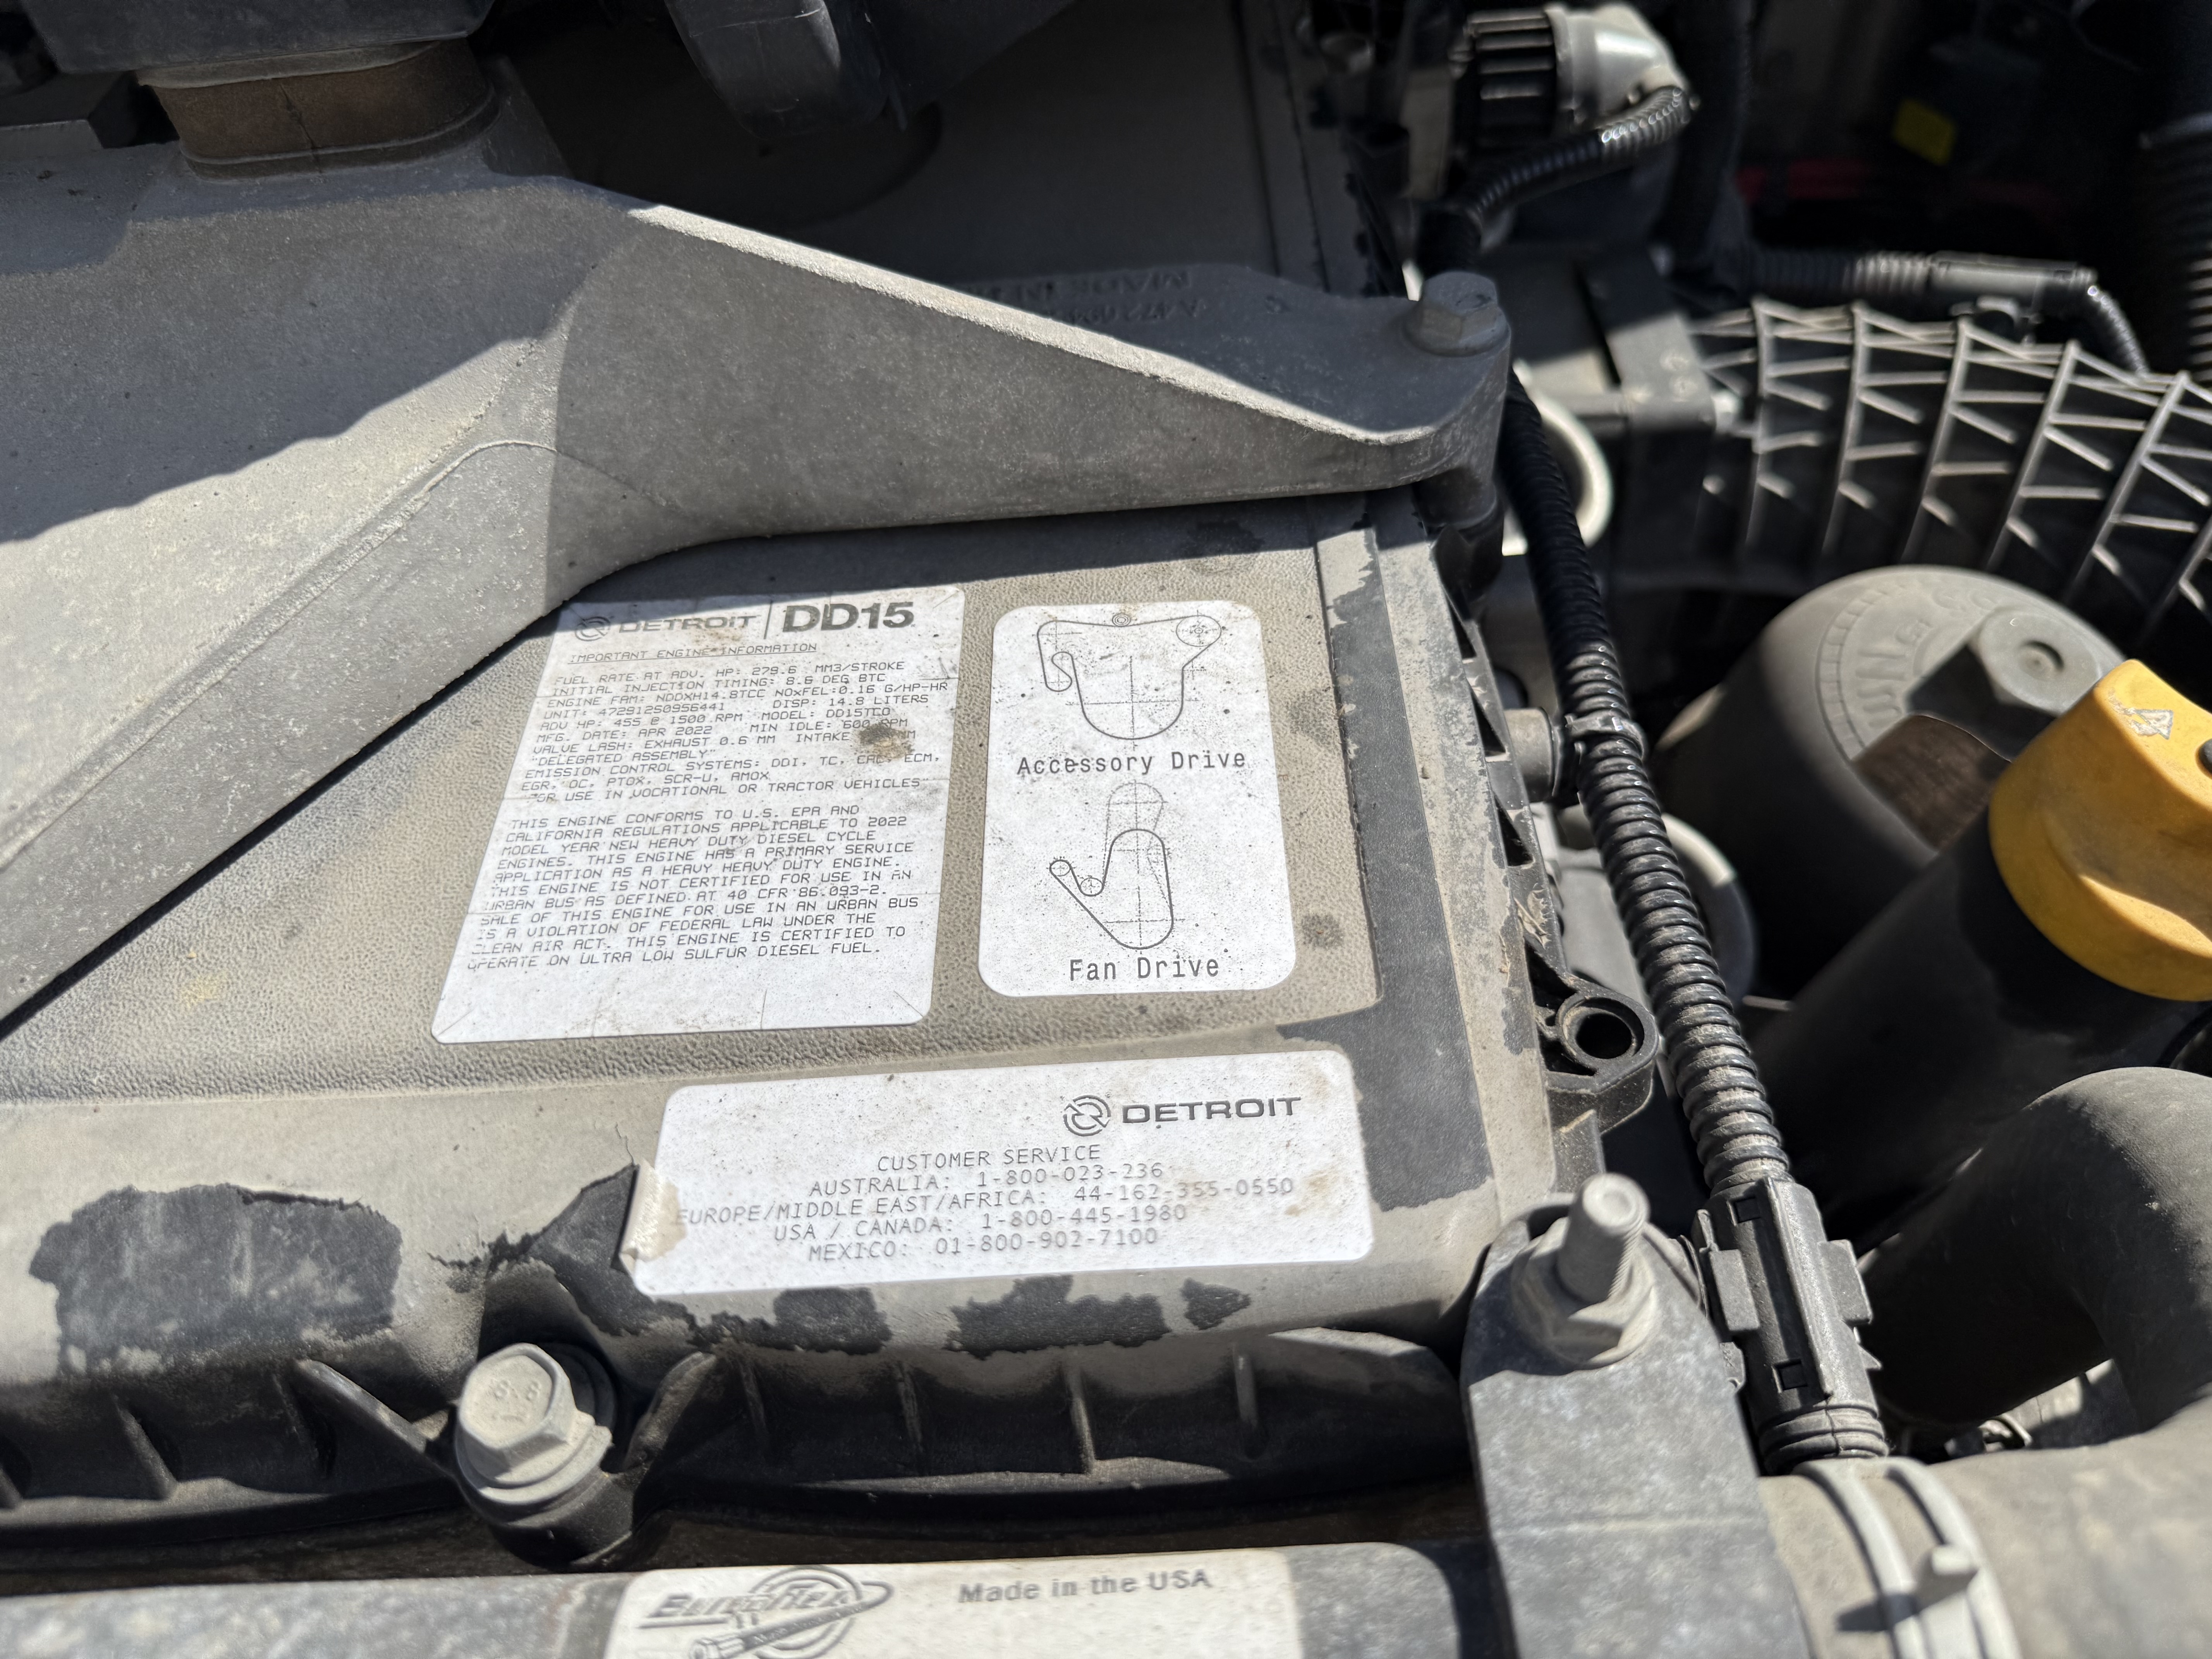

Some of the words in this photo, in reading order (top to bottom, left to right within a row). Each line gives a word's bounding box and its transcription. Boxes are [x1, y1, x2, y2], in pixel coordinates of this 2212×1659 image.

[619, 615, 758, 634] DETROIT
[782, 602, 914, 632] DD15
[570, 651, 648, 663] IMPORTANT
[656, 648, 711, 658] ENGINE
[718, 643, 817, 655] INFORMATION
[550, 685, 612, 697] INITIAL
[624, 680, 704, 692] INJECTION
[714, 677, 774, 687] TIMING:
[786, 675, 813, 685] 8.6
[822, 674, 849, 684] DEG
[859, 673, 885, 682] BTC
[554, 676, 588, 685] FUEL
[599, 673, 635, 682] RATE
[670, 670, 704, 678] ADV.
[715, 668, 740, 677] HP:
[752, 665, 797, 675] 279.6
[815, 661, 905, 673] MM3/STROKE
[543, 709, 587, 719] UNIT:
[772, 699, 816, 708] DISP:
[829, 696, 864, 706] 14.8
[874, 694, 928, 704] LITERS
[547, 697, 602, 708] ENGINE
[610, 696, 644, 704] FAM:
[656, 689, 765, 702] NDDXH14.8TCC
[884, 680, 948, 692] G/HP-HR
[536, 733, 570, 742] MFG.
[582, 730, 626, 740] DATE:
[638, 728, 666, 737] APR
[675, 725, 712, 735] 2022
[749, 723, 777, 732] MIN
[788, 721, 831, 731] IDLE:
[843, 720, 870, 729] 600
[880, 718, 907, 726] RPM
[540, 721, 568, 730] ADV
[576, 720, 602, 728] HP:
[613, 717, 642, 726] 455
[650, 717, 659, 725] @
[670, 714, 706, 725] 1500
[714, 713, 742, 722] RPM
[761, 711, 814, 720] MODEL:
[532, 744, 580, 754] VALVE
[588, 742, 632, 752] LASH:
[644, 737, 710, 749] EXHAUST
[719, 736, 747, 745] 0.6
[756, 735, 775, 744] MM
[795, 730, 850, 743] INTAKE
[525, 767, 601, 778] EMISSION
[610, 763, 675, 774] CONTROL
[685, 759, 759, 770] SYSTEMS:
[771, 757, 806, 767] DDI,
[819, 756, 844, 765] TC,
[904, 750, 939, 761] ECM,
[632, 749, 715, 761] ASSEMBLY"
[1017, 756, 1152, 775] Accessory
[1171, 751, 1246, 769] Drive
[520, 779, 559, 791] EGR,
[606, 776, 651, 787] PTOX,
[664, 773, 718, 784] SCR-U,
[731, 771, 769, 781] AMOX
[565, 790, 594, 801] USE
[632, 785, 727, 799] VOCATIONAL
[768, 780, 834, 792] TRACTOR
[505, 828, 603, 842] CALIFORNIA
[612, 823, 721, 837] REGULATIONS
[730, 819, 828, 832] APPLICABLE
[868, 816, 907, 826] 2022
[511, 818, 549, 829] THIS
[557, 814, 617, 827] ENGINE
[625, 811, 704, 823] CONFORMS
[742, 808, 778, 818] U.S.
[791, 806, 820, 817] EPA
[830, 805, 859, 815] AND
[497, 856, 572, 869] ENGINES.
[588, 854, 626, 865] THIS
[635, 850, 696, 862] ENGINE
[705, 848, 735, 859] HAS
[764, 845, 834, 857] PRIMARY
[844, 842, 914, 854] SERVICE
[501, 844, 549, 856] MODEL
[561, 842, 599, 853] YEAR
[609, 840, 639, 850] NEW
[648, 836, 698, 848] HEAVY
[708, 835, 747, 846] DUTY
[757, 833, 815, 844] DIESEL
[826, 830, 875, 842] CYCLE
[493, 869, 603, 883] APPLICATION
[662, 864, 712, 875] HEAVY
[722, 860, 773, 872] HEAVY
[782, 858, 822, 870] DUTY
[833, 855, 903, 868] ENGINE.
[538, 882, 599, 895] ENGINE
[639, 878, 670, 890] NOT
[679, 874, 769, 888] CERTIFIED
[780, 872, 810, 884] FOR
[820, 871, 850, 883] USE
[544, 897, 575, 908] BUS
[615, 891, 686, 905] DEFINED
[727, 889, 747, 900] 40
[757, 887, 788, 899] CFR
[798, 883, 886, 897] 86.093-2.
[563, 910, 602, 922] THIS
[611, 906, 673, 919] ENGINE
[683, 905, 714, 916] FOR
[724, 903, 755, 914] USE
[826, 898, 878, 910] URBAN
[888, 895, 918, 908] BUS
[527, 923, 619, 937] VIOLATION
[659, 918, 730, 931] FEDERAL
[742, 917, 773, 928] LAW
[783, 914, 835, 927] UNDER
[846, 912, 876, 924] THE
[532, 940, 563, 952] AIR
[573, 938, 611, 950] ACT.
[627, 935, 667, 948] THIS
[677, 932, 739, 946] ENGINE
[781, 927, 874, 941] CERTIFIED
[548, 955, 570, 966] ON
[579, 951, 632, 964] ULTRA
[642, 950, 674, 962] LOW
[684, 946, 747, 960] SULFUR
[757, 944, 820, 957] DIESEL
[831, 940, 879, 954] FUEL.
[1070, 959, 1116, 981] Fan
[1138, 957, 1219, 978] Drive
[1122, 1097, 1301, 1124] DETROIT
[878, 1151, 990, 1172] CUSTOMER
[1003, 1144, 1101, 1165] SERVICE
[810, 1175, 950, 1197] AUSTRALIA:
[977, 1163, 1163, 1187] 1-800-023-236
[677, 1199, 864, 1225] EUROPE/MIDDLE
[876, 1191, 1047, 1215] EAST/AFRICA:
[775, 1223, 817, 1241] USA
[855, 1216, 953, 1237] CANADA:
[983, 1204, 1187, 1229] 1-800-445-1980
[809, 1241, 907, 1262] MEXICO:
[935, 1228, 1158, 1255] 01-800-902-7100
[958, 1580, 1039, 1603] Made
[1052, 1578, 1077, 1597] in
[1090, 1575, 1137, 1595] the
[1149, 1569, 1213, 1590] USA
